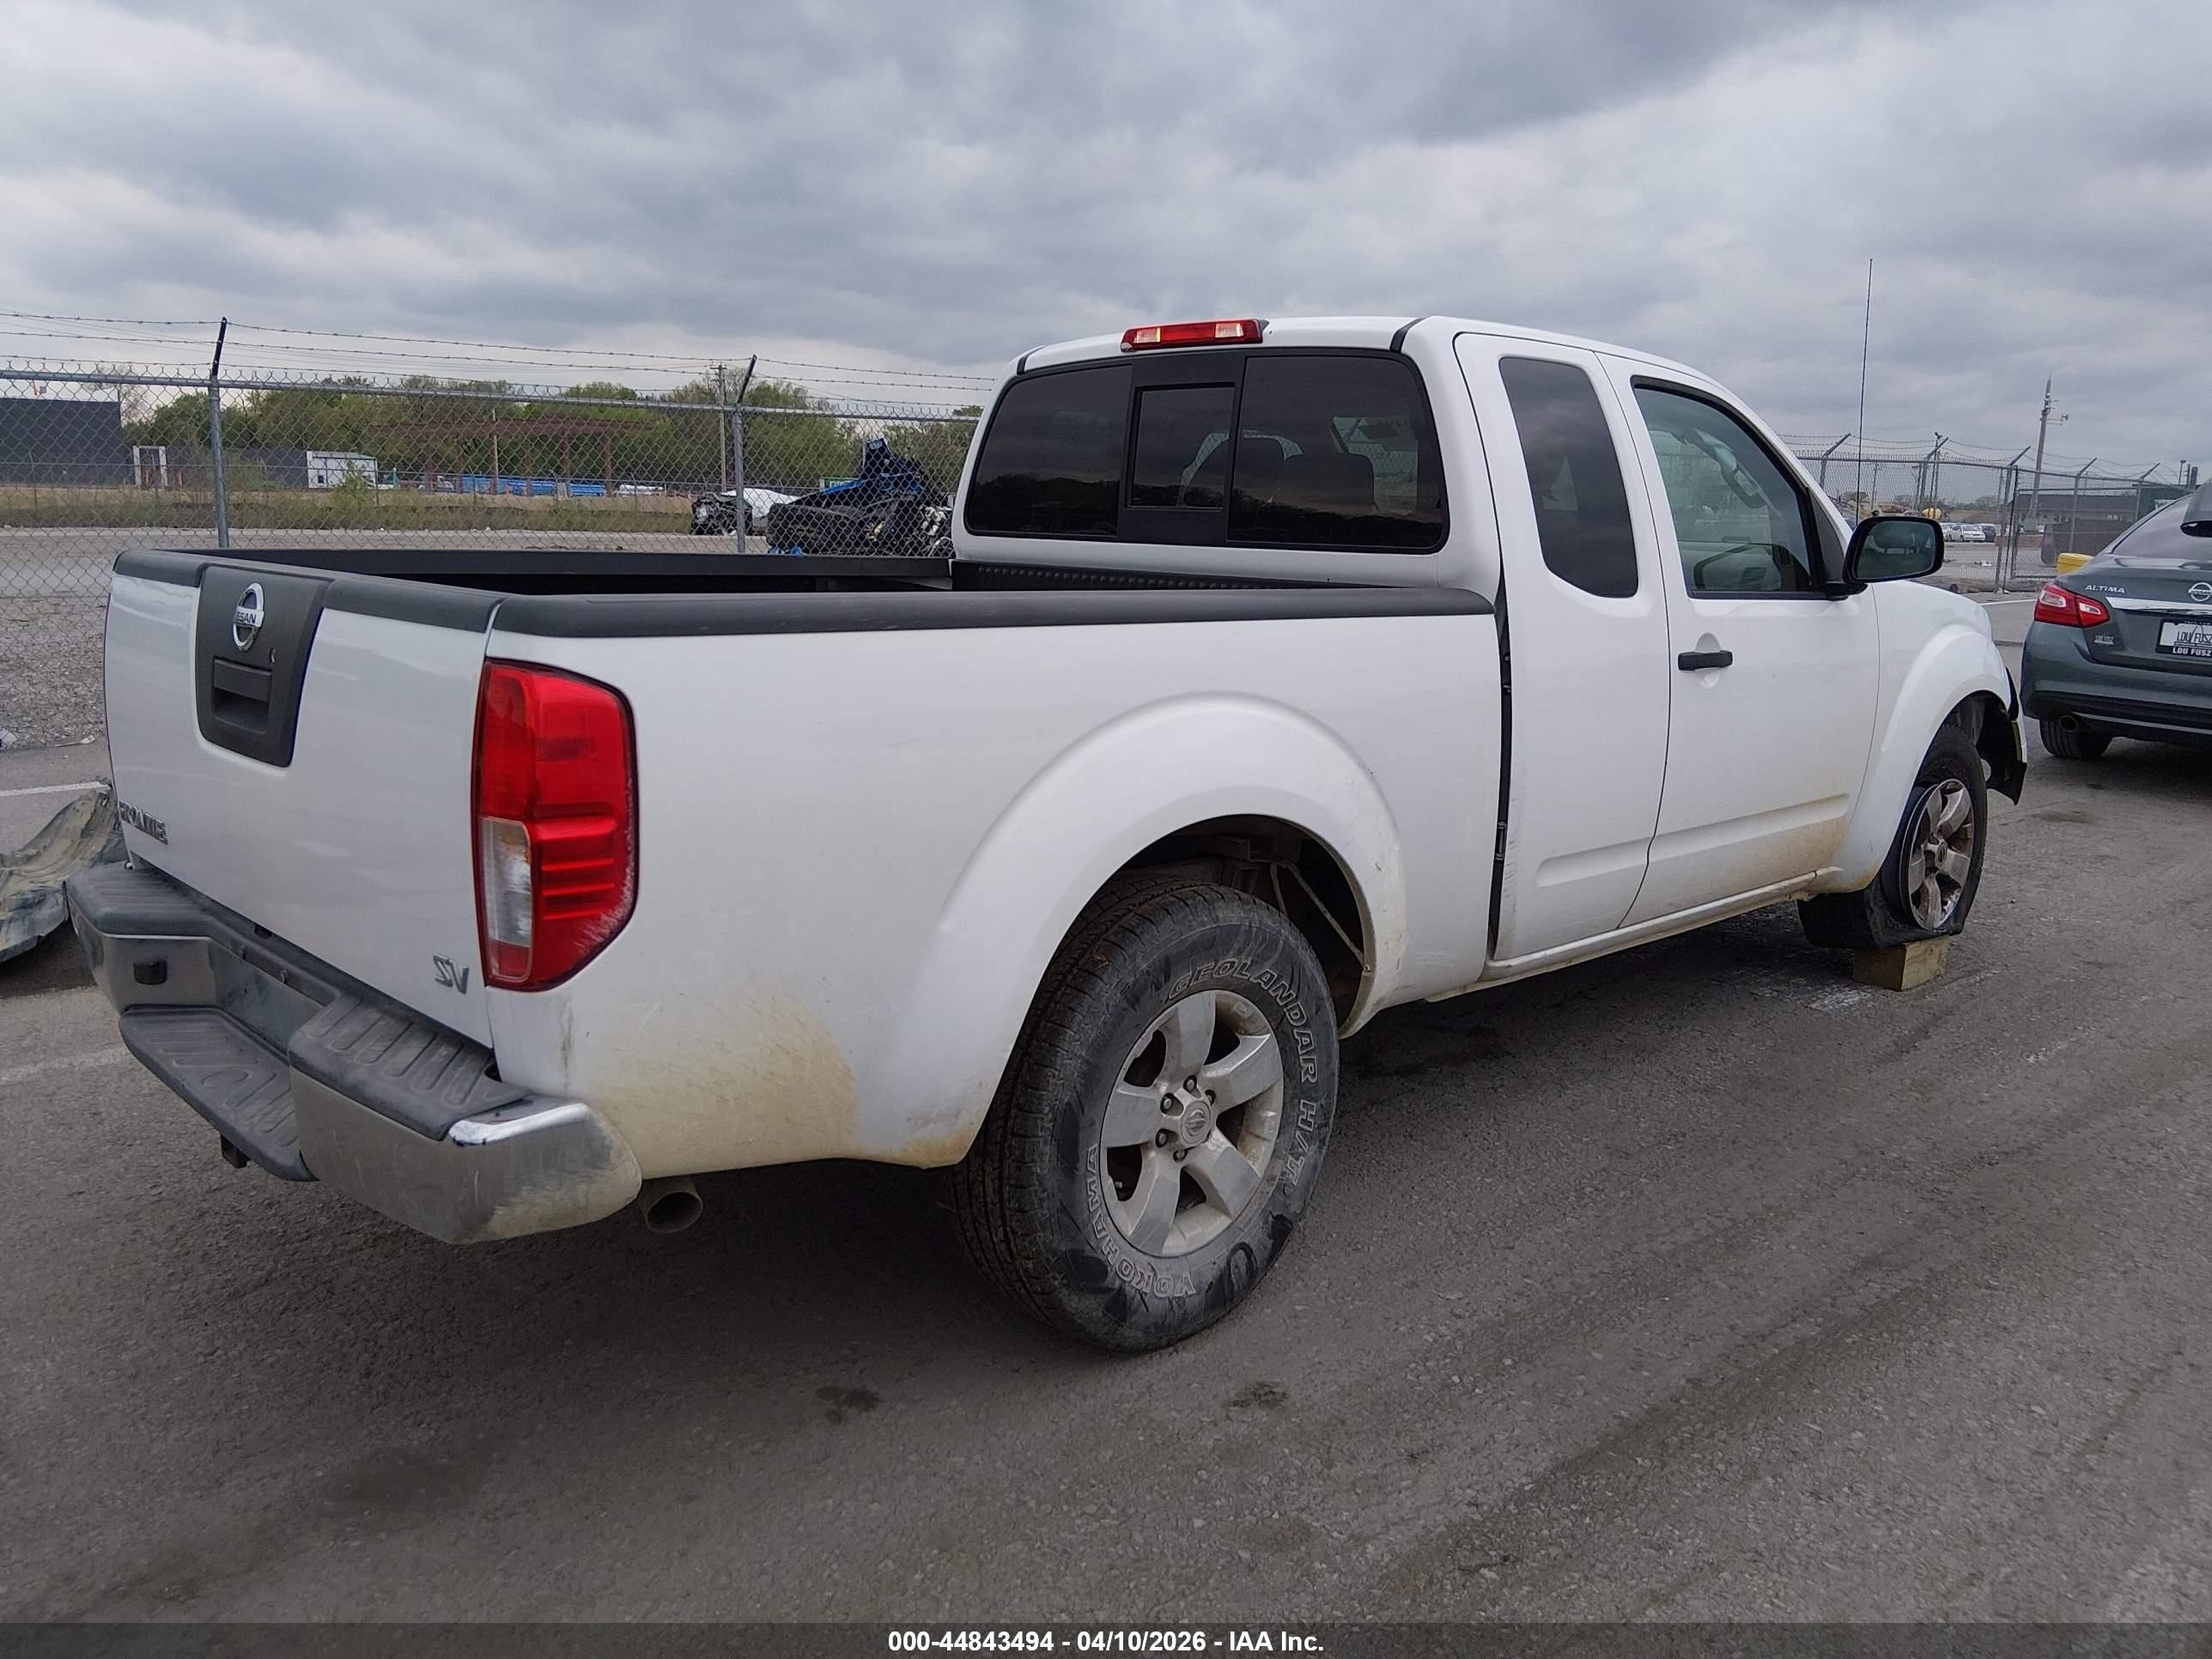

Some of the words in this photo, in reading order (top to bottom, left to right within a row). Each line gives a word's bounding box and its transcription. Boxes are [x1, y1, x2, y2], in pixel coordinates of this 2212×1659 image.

[2084, 585, 2125, 593] ALTIMA
[2176, 631, 2192, 642] LOU
[2191, 648, 2212, 657] FUSZ
[433, 953, 470, 995] SV
[1167, 957, 1318, 1085] GEOLANDAR
[1086, 1143, 1196, 1298] YOKOHAMA
